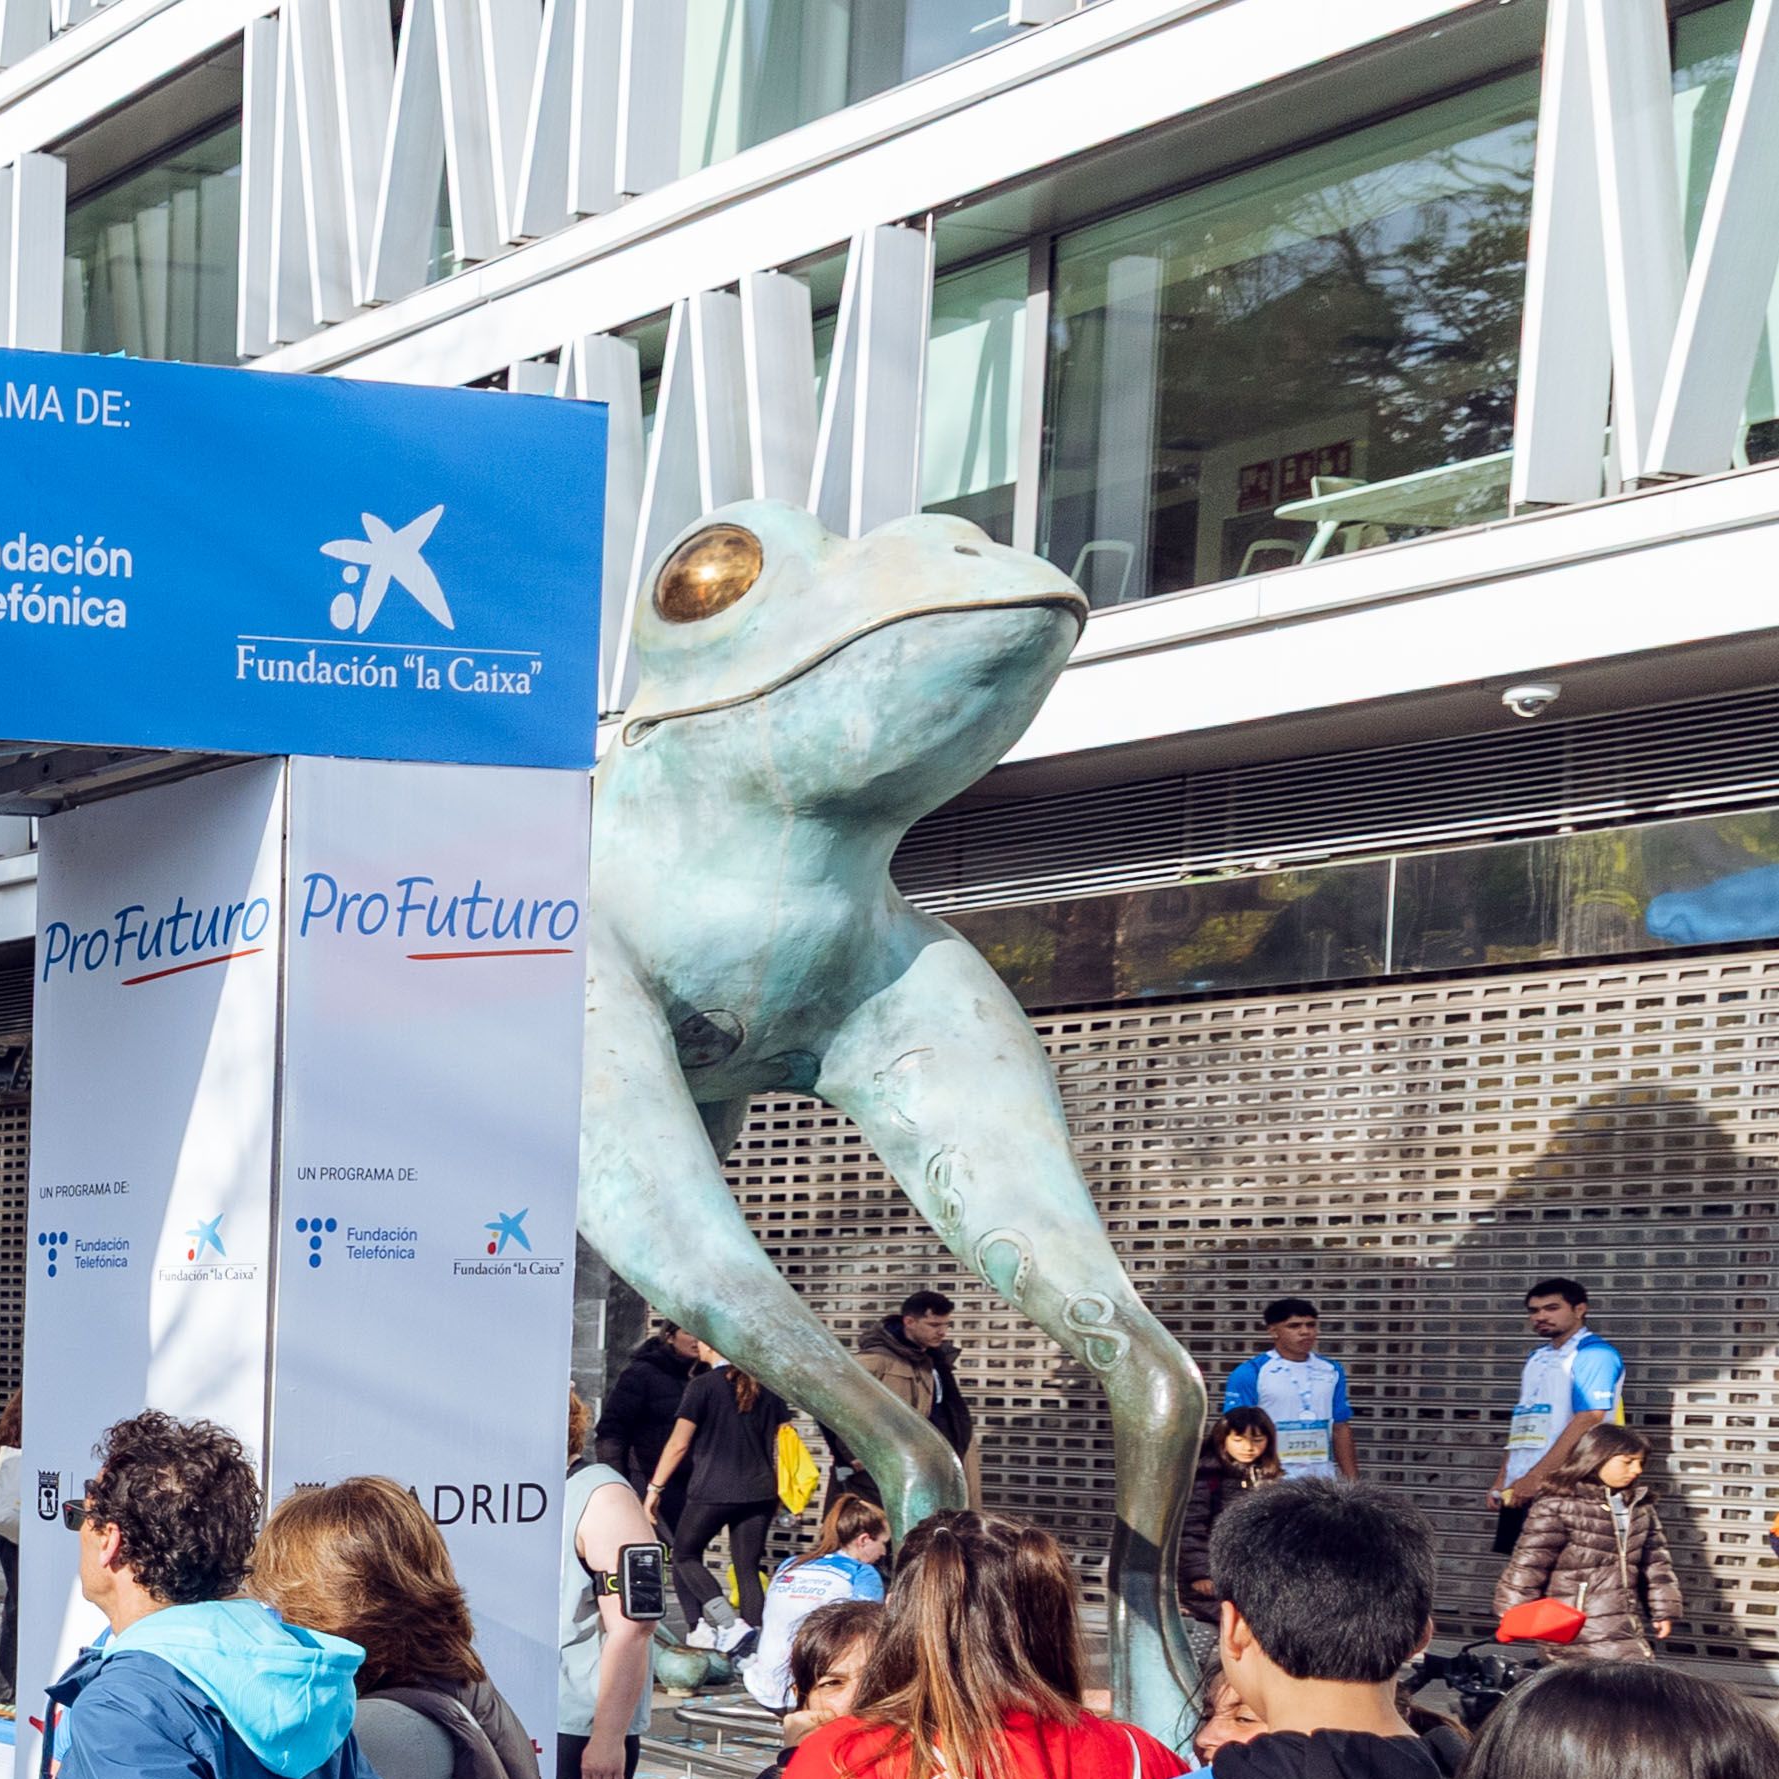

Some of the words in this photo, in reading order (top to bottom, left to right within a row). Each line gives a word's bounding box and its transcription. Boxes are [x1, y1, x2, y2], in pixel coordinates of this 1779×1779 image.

[75, 389, 130, 428] DE:
[236, 644, 398, 689] Fundación
[299, 872, 580, 942] ProFuturo
[42, 895, 269, 982] ProFuturo
[298, 1167, 316, 1180] UN
[320, 1168, 394, 1181] PROGRAMA
[399, 1168, 418, 1181] DE:
[39, 1186, 53, 1199] UN
[55, 1182, 111, 1199] PROGRAMA
[113, 1181, 130, 1194] DE:
[347, 1226, 418, 1242] Fundación
[75, 1237, 130, 1252] Fundación
[347, 1244, 416, 1260] Telefónica
[75, 1254, 128, 1269] Telefónica
[453, 1261, 512, 1276] Fundación
[159, 1266, 209, 1282] Fundación
[406, 1483, 548, 1525] DRID
